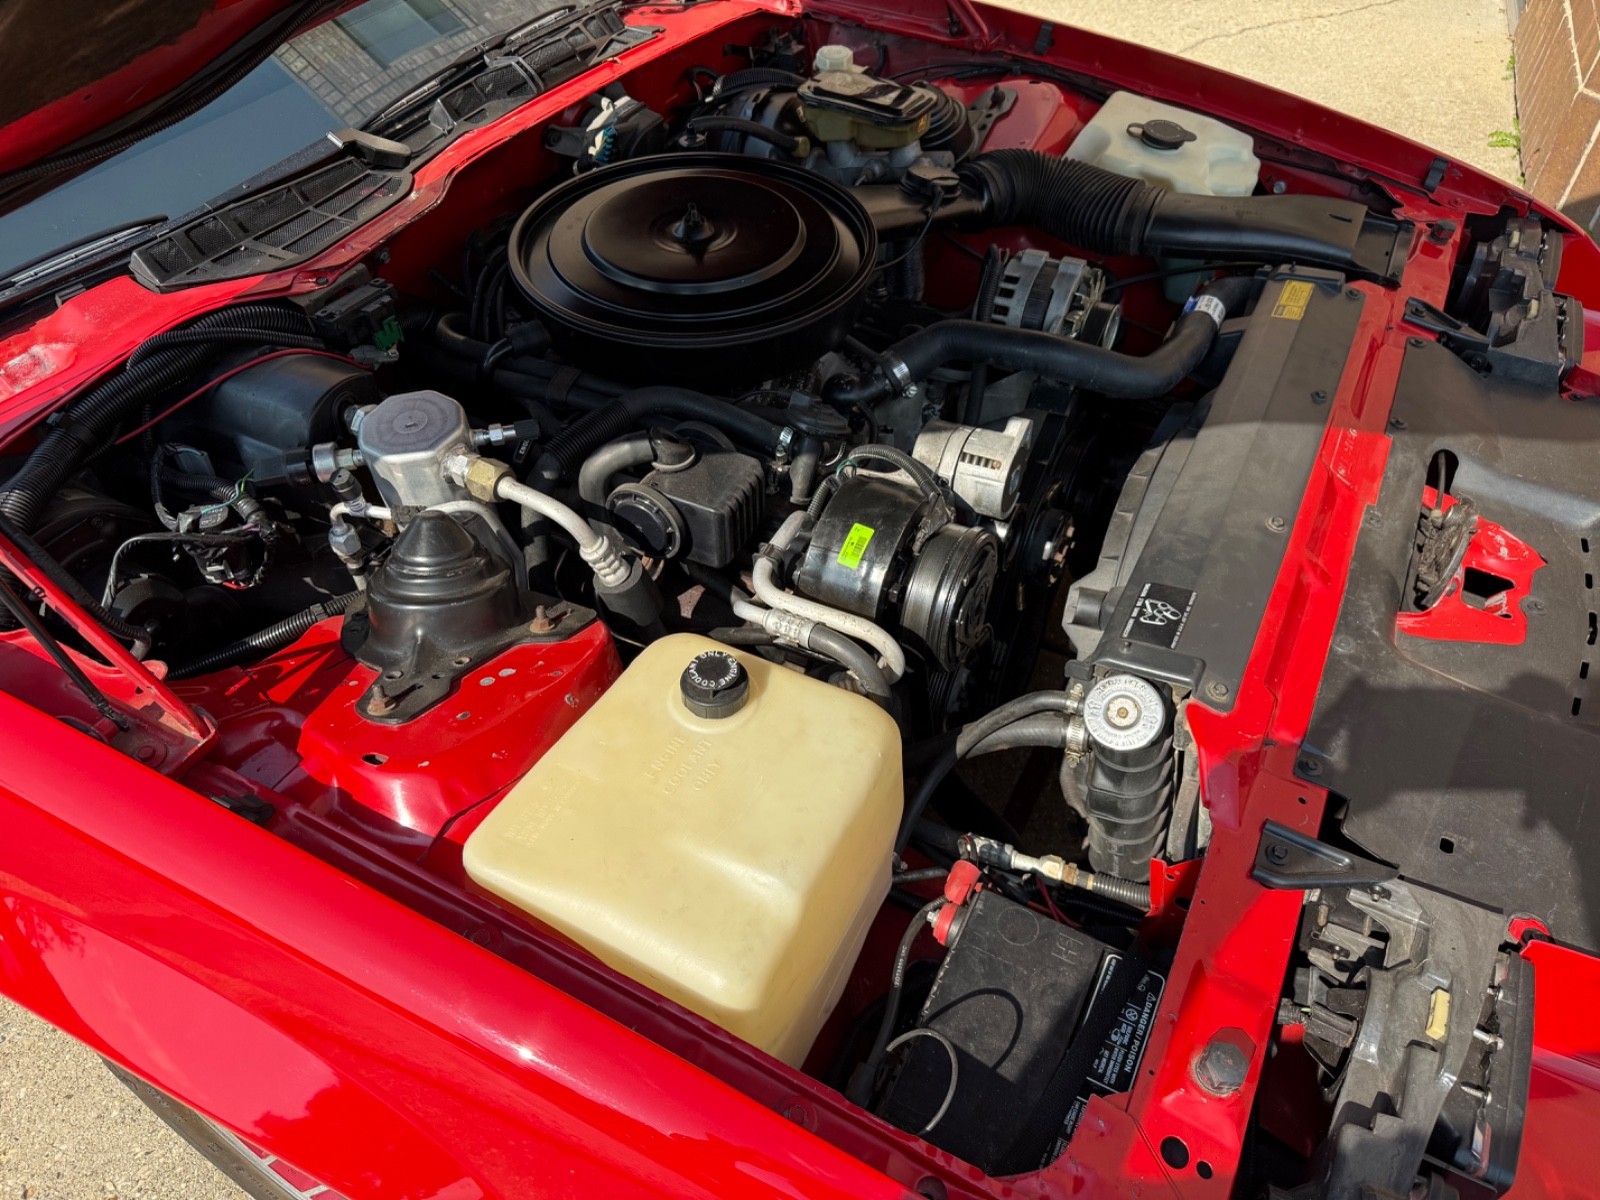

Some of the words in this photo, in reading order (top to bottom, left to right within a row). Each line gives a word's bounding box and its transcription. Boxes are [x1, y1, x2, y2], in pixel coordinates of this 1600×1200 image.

[699, 650, 728, 659] ONLY
[688, 658, 716, 687] COOLANT
[718, 657, 738, 686] ENGINE
[644, 735, 688, 779] ENGINE
[662, 739, 712, 794] COOLANT
[692, 760, 720, 791] ONLY
[1124, 1001, 1153, 1073] DANGER/POISON
